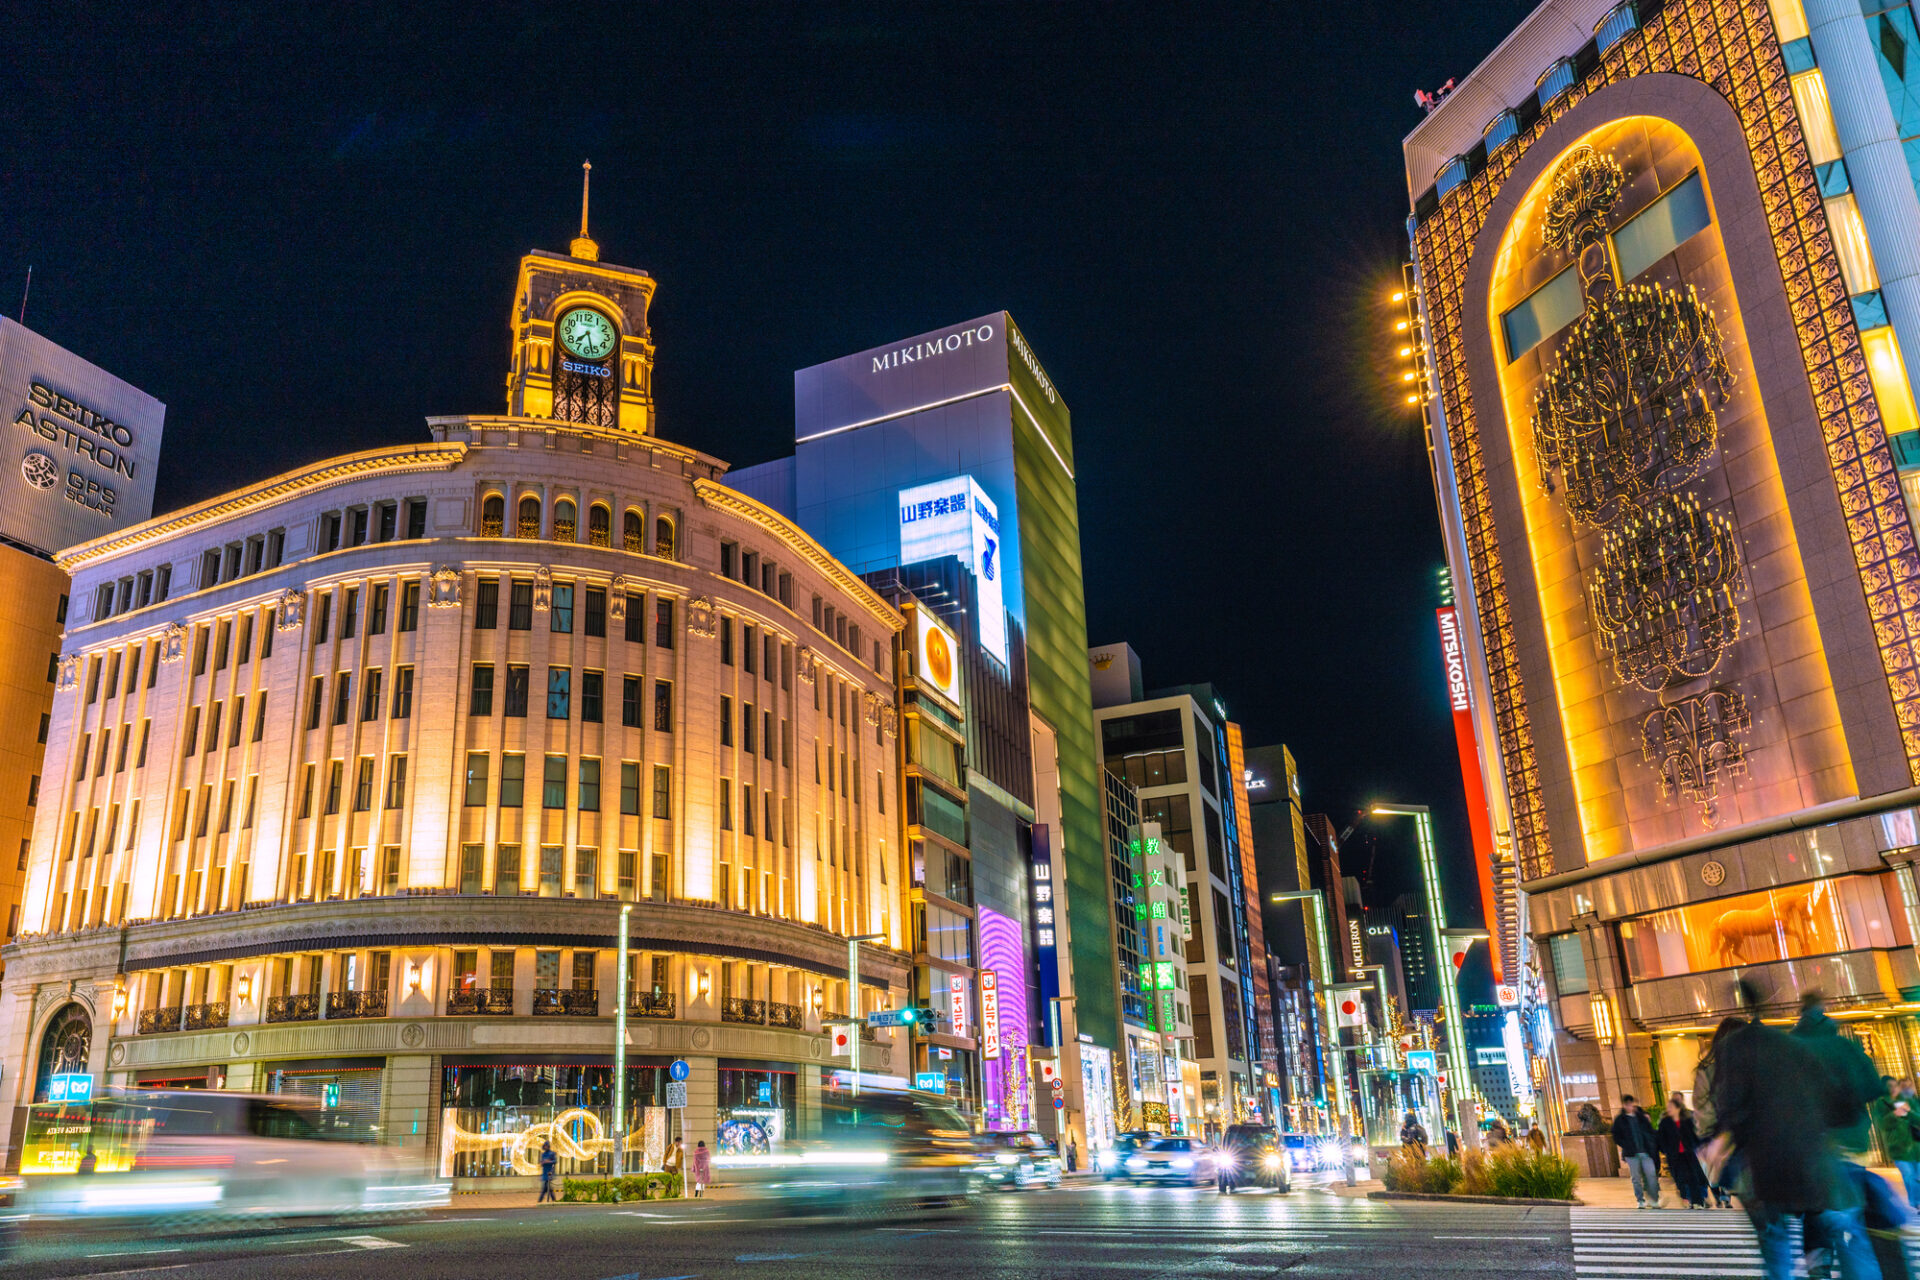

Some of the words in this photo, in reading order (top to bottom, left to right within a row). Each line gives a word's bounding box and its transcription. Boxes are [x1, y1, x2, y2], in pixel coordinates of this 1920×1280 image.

[568, 319, 576, 327] 10
[576, 314, 582, 322] 11
[584, 314, 593, 322] 12
[601, 324, 608, 332] 2
[568, 335, 574, 343] 8
[576, 342, 582, 350] 7
[604, 334, 610, 342] 3
[872, 325, 993, 373] MIKIMOTO
[563, 361, 610, 377] SEIKO
[1012, 328, 1055, 404] MIKIMOTO
[28, 381, 132, 447] SEIKO
[13, 409, 135, 480] ASTRON
[64, 488, 113, 519] SOLAR
[66, 472, 115, 505] GPS
[901, 493, 966, 524] 山野楽器
[1440, 613, 1468, 711] MITSUKOSHI
[1145, 837, 1166, 919] 教文館
[1034, 864, 1054, 946] 山野楽器
[1366, 926, 1390, 935] OLA
[1349, 920, 1365, 980] BUCHERON
[984, 994, 997, 1054] キムラヤのパン
